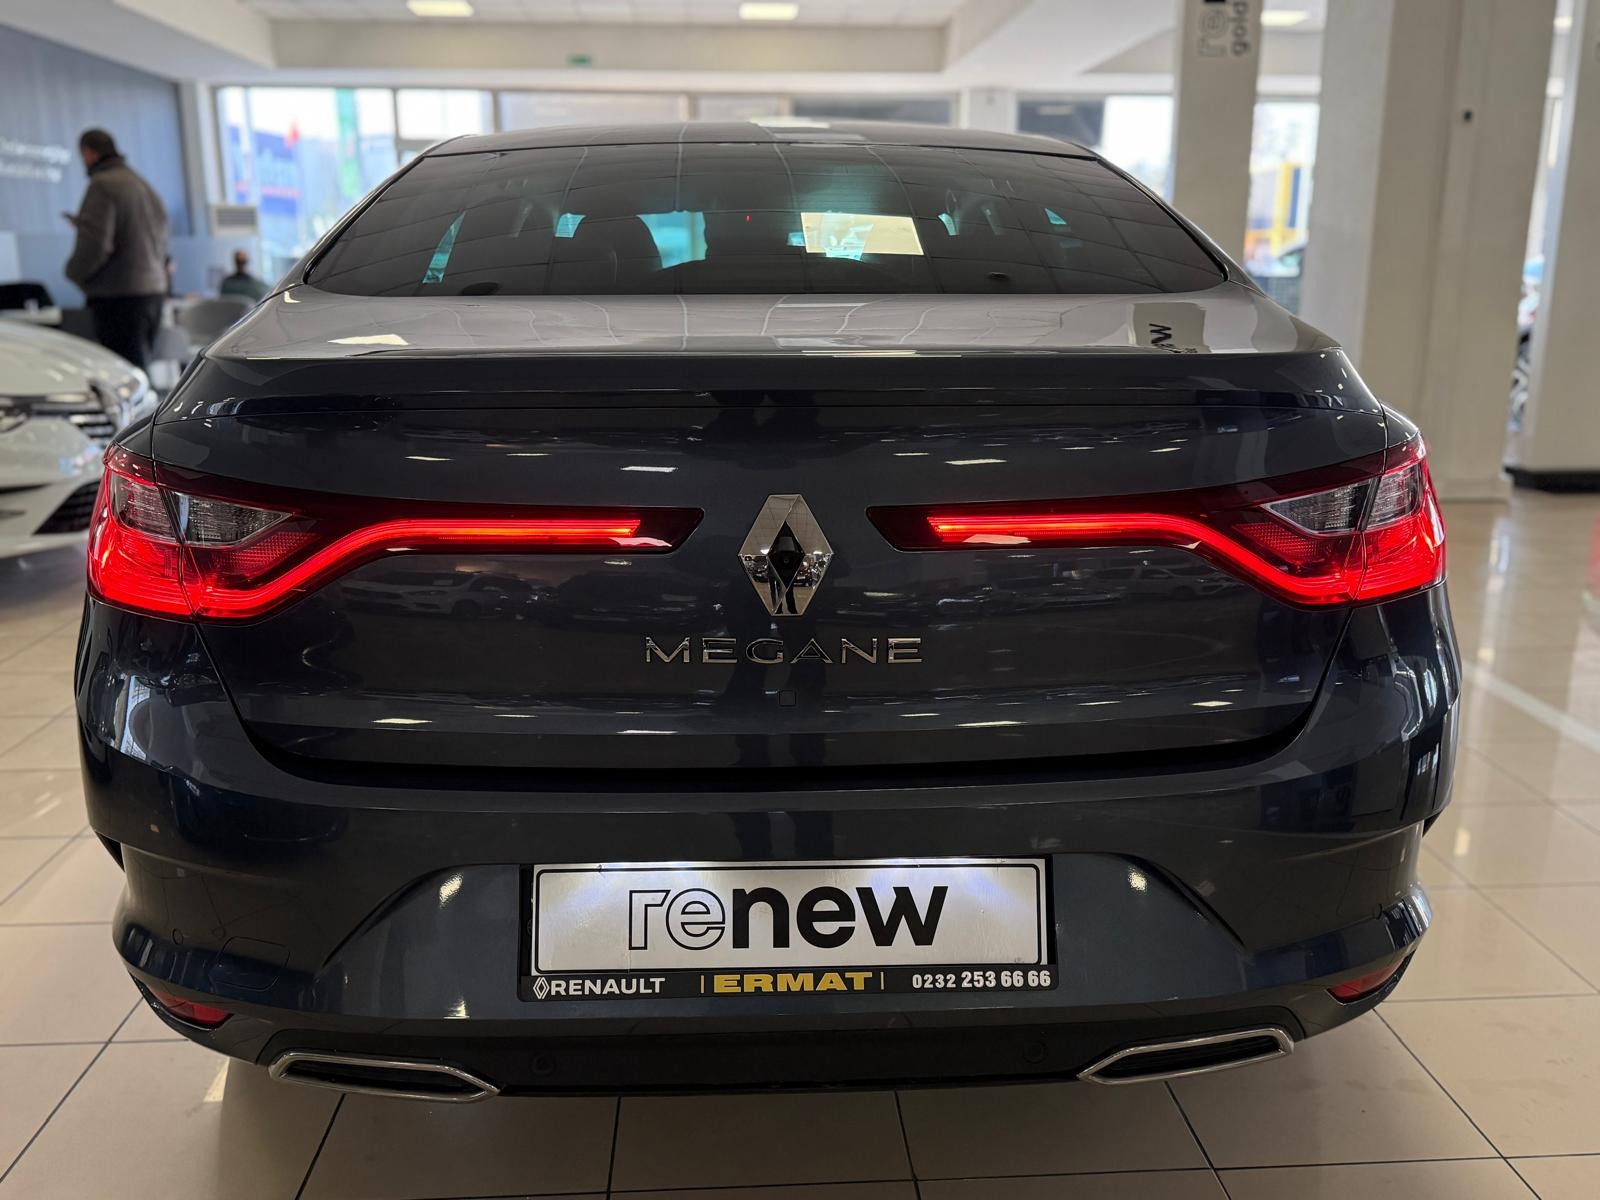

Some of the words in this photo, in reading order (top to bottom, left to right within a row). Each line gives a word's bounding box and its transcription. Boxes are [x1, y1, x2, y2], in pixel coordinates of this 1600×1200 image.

[645, 637, 923, 664] MEGANE
[628, 886, 949, 951] renew
[551, 977, 666, 996] RENAULT
[713, 971, 873, 993] ERMAT
[912, 973, 956, 989] 0232
[961, 970, 997, 988] 253
[1000, 970, 1024, 987] 66
[1027, 970, 1051, 987] 66
